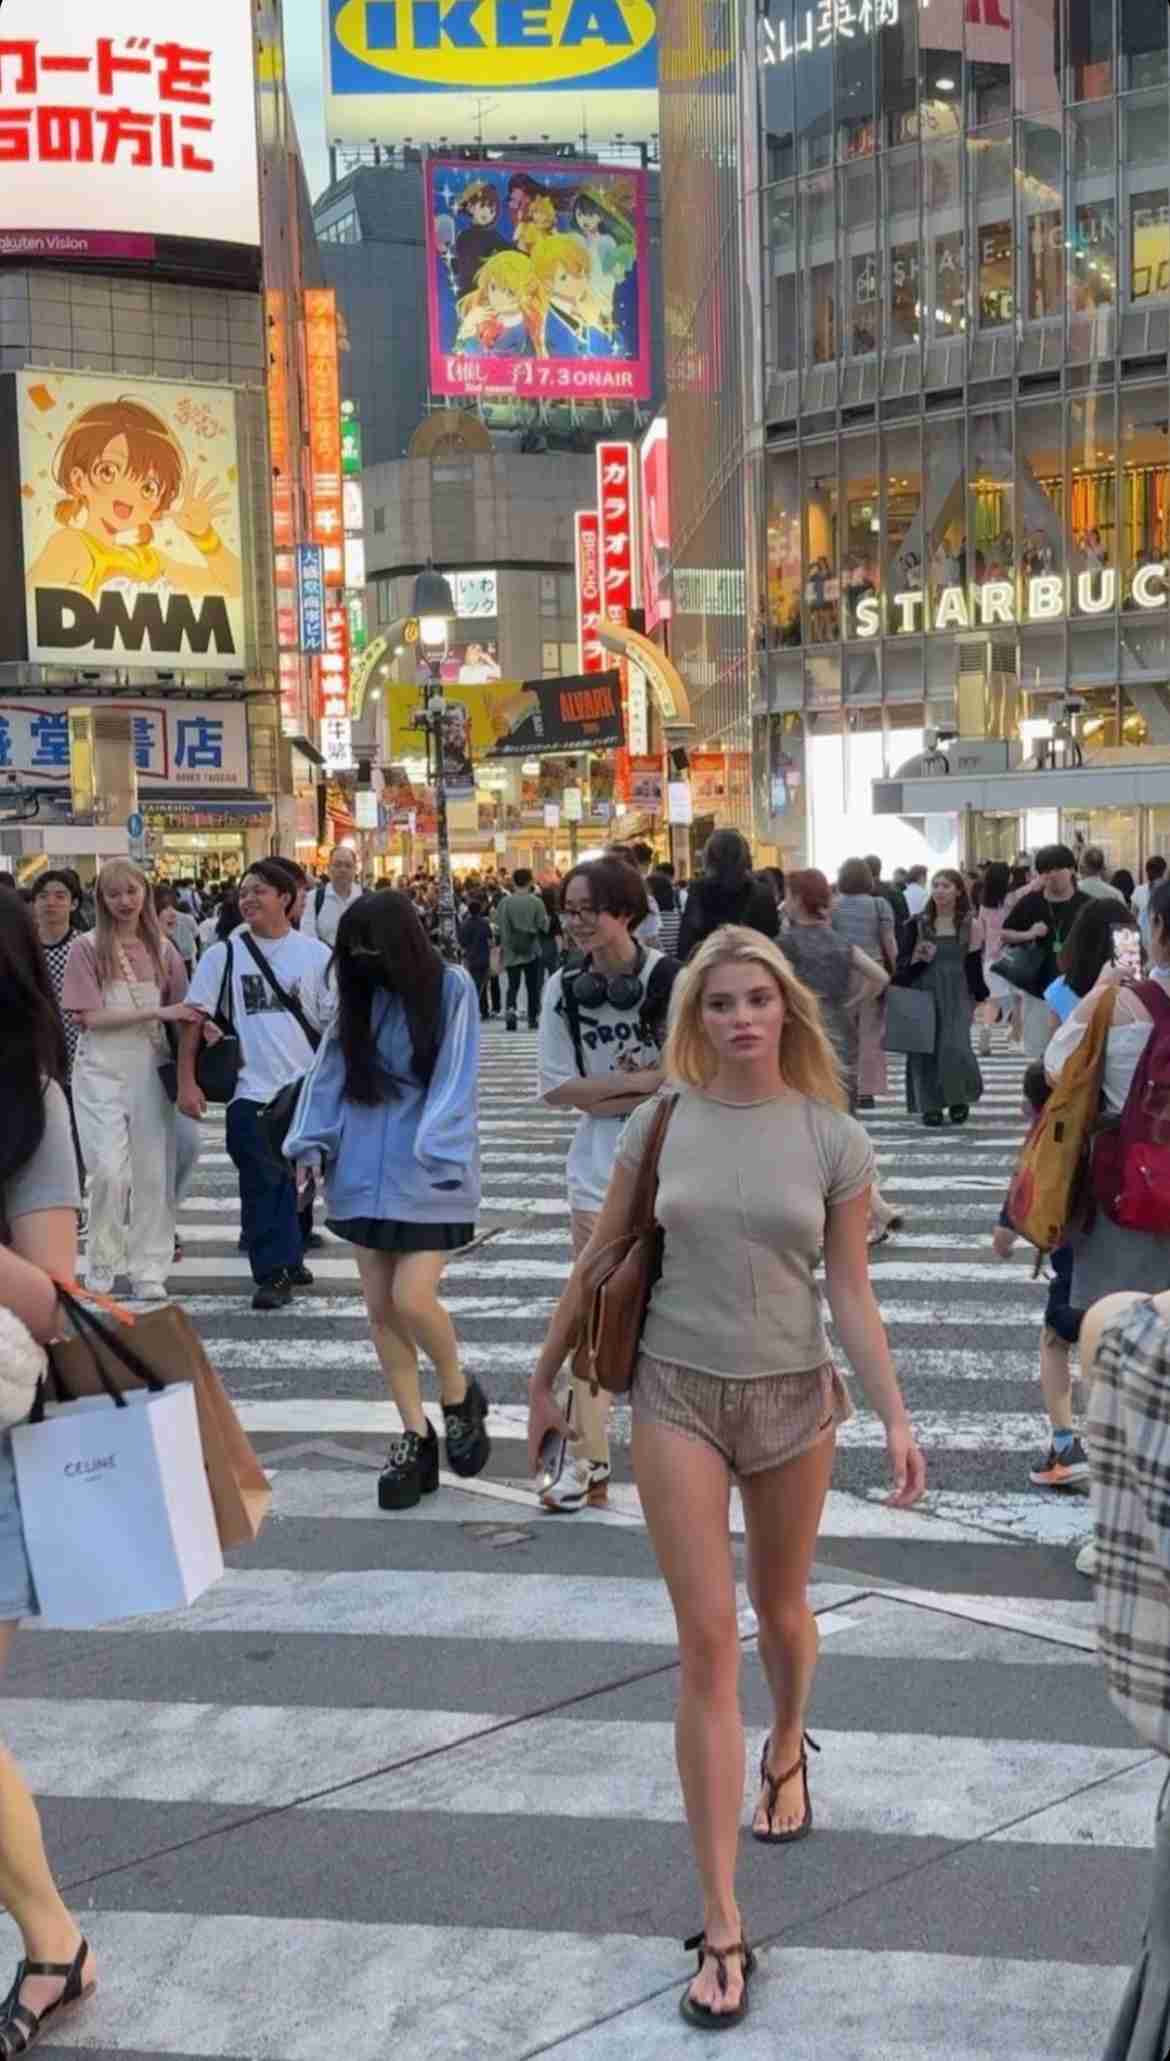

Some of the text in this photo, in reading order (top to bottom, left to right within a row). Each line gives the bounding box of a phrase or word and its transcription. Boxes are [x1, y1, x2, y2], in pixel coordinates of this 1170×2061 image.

[365, 0, 635, 50] IKEA
[0, 37, 212, 105] カードを
[46, 236, 88, 249] Vision
[604, 462, 629, 589] カラオケ
[35, 586, 236, 655] DMM
[0, 713, 223, 768] 堂店
[63, 1454, 117, 1476] CELINE
